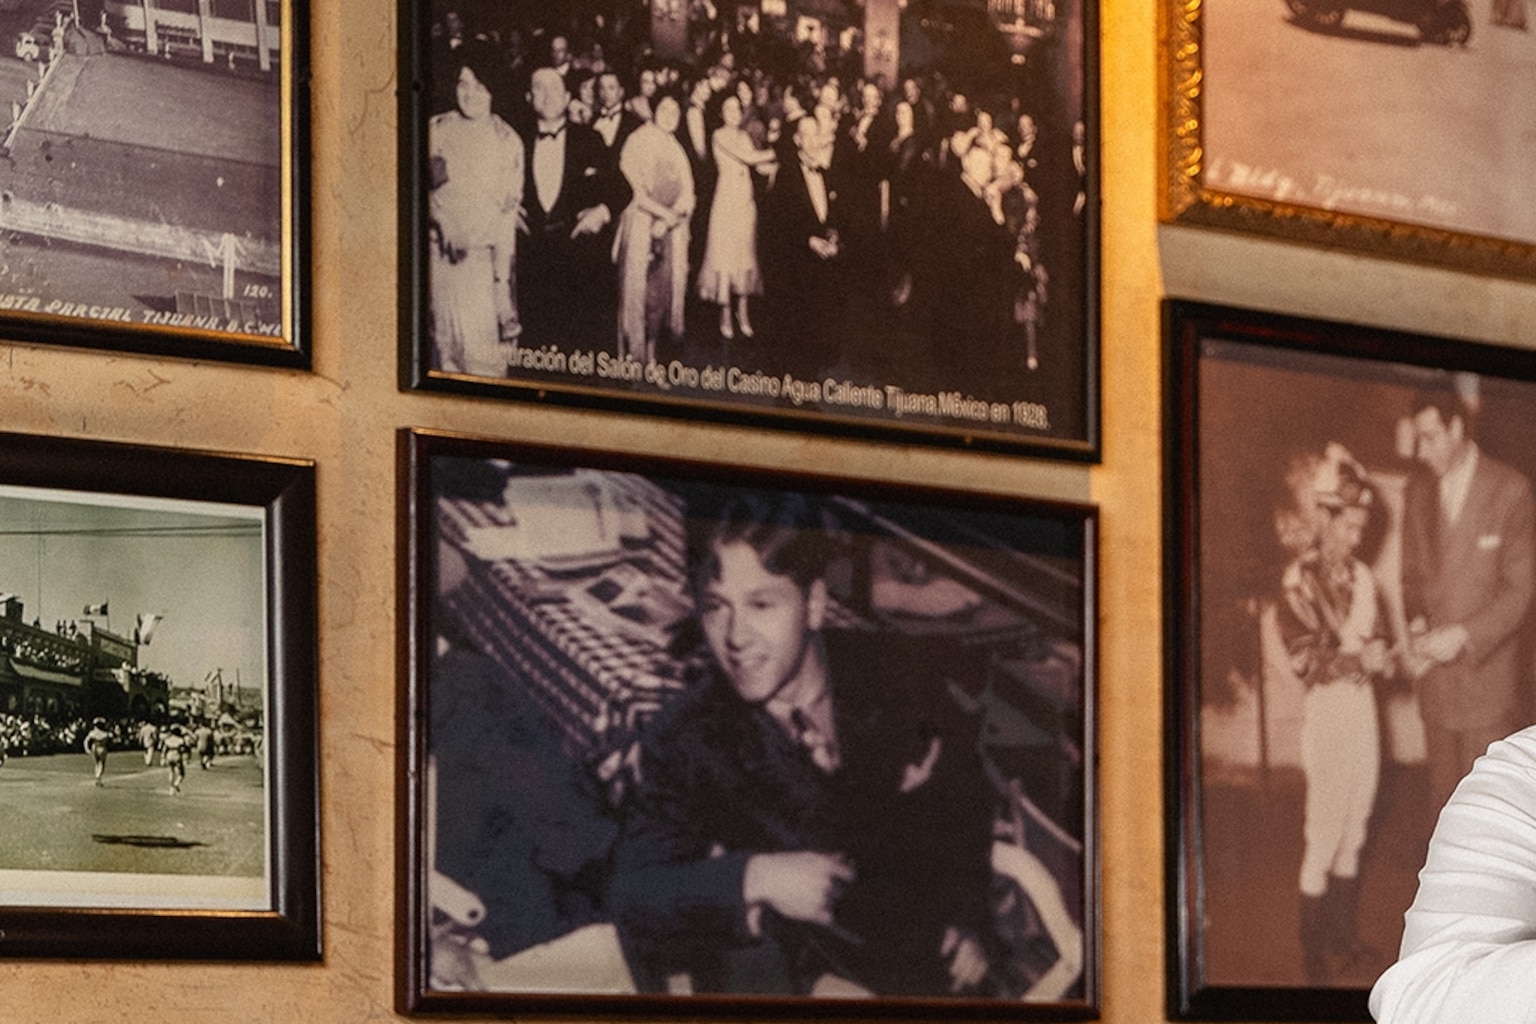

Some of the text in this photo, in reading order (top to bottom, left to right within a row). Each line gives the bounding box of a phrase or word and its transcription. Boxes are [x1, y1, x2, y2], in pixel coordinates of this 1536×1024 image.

[45, 299, 131, 322] PARCIAL
[506, 344, 567, 373] uración
[568, 348, 595, 376] del
[596, 351, 643, 381] Salón
[644, 358, 667, 385] de
[668, 360, 699, 388] Oro
[700, 364, 726, 392] del
[727, 366, 781, 398] Casino
[781, 372, 822, 406] Agua
[822, 378, 884, 410] Caliente
[990, 402, 1010, 424] en
